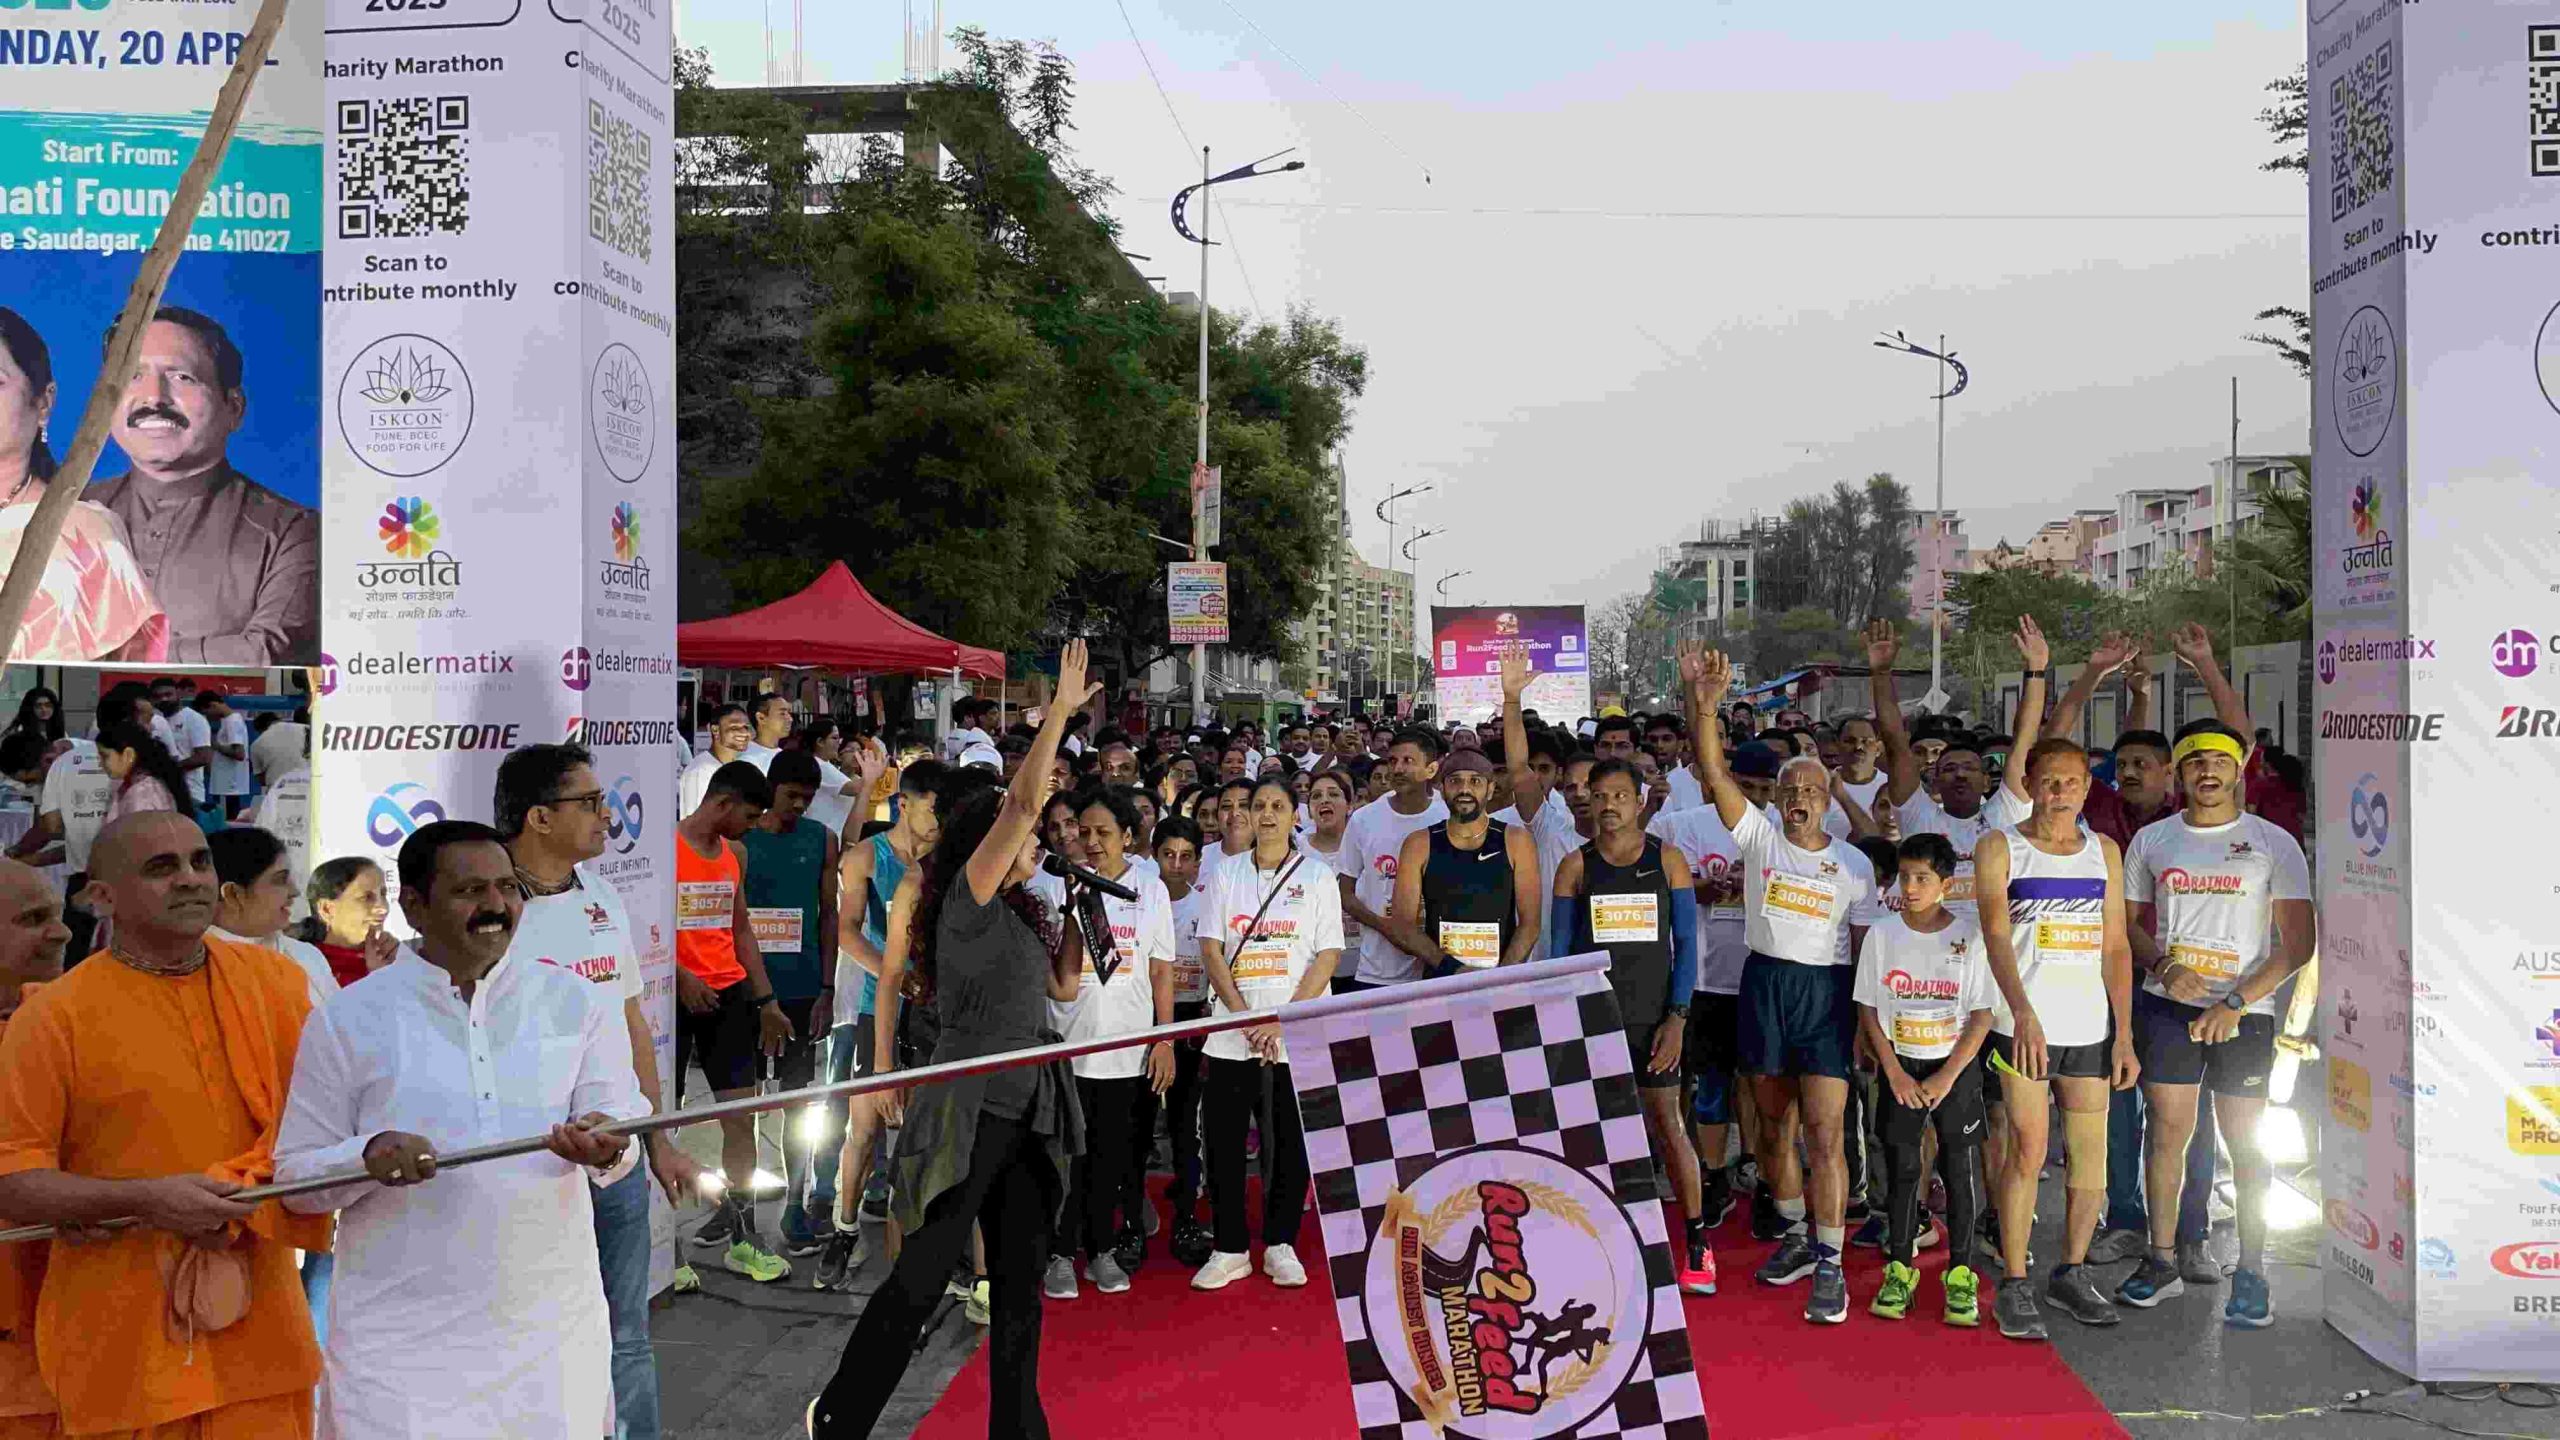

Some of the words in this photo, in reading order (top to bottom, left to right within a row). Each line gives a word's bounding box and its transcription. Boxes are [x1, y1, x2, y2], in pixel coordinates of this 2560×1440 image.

[120, 30, 164, 65] 20
[2316, 30, 2353, 68] Charity
[395, 54, 504, 75] Marathon
[565, 50, 615, 91] Charity
[616, 75, 665, 125] Marathon
[43, 139, 104, 163] Start
[111, 142, 179, 165] From:
[22, 227, 147, 256] Saudagar,
[218, 229, 290, 251] 411027
[2344, 226, 2369, 250] Scan
[2372, 217, 2384, 236] to
[364, 254, 418, 273] Scan
[424, 254, 447, 272] to
[2313, 256, 2368, 295] contribute
[2369, 229, 2439, 267] monthly
[421, 278, 517, 301] monthly
[602, 260, 630, 287] Scan
[632, 278, 643, 295] to
[553, 280, 628, 315] contribute
[630, 303, 673, 339] monthly
[370, 412, 442, 427] ISKCON
[366, 443, 396, 453] FOOD
[399, 443, 421, 452] FOR
[424, 442, 446, 451] LIFE
[2342, 530, 2393, 574] उन्नति
[357, 550, 462, 588] उन्नति
[600, 556, 651, 592] उन्नति
[595, 648, 673, 675] dealermatix
[2339, 634, 2437, 663] dealermatix
[348, 650, 514, 677] dealermatix
[567, 717, 675, 747] BRIDGESTONE
[2321, 710, 2445, 742] BRIDGESTONE
[599, 861, 619, 876] BLUE
[620, 856, 651, 872] INFINITY
[2172, 875, 2242, 889] MARATHON
[1776, 889, 1817, 908] 3060
[1604, 910, 1641, 922] 3076
[2051, 928, 2089, 942] 3063
[1895, 980, 1960, 995] MARATHON
[2519, 1203, 2547, 1214] Four
[1402, 1225, 1420, 1258] RUN
[1401, 1261, 1425, 1328] AGAINST
[1411, 1328, 1448, 1394] HUNGER
[1441, 1285, 1488, 1417] MARATHON
